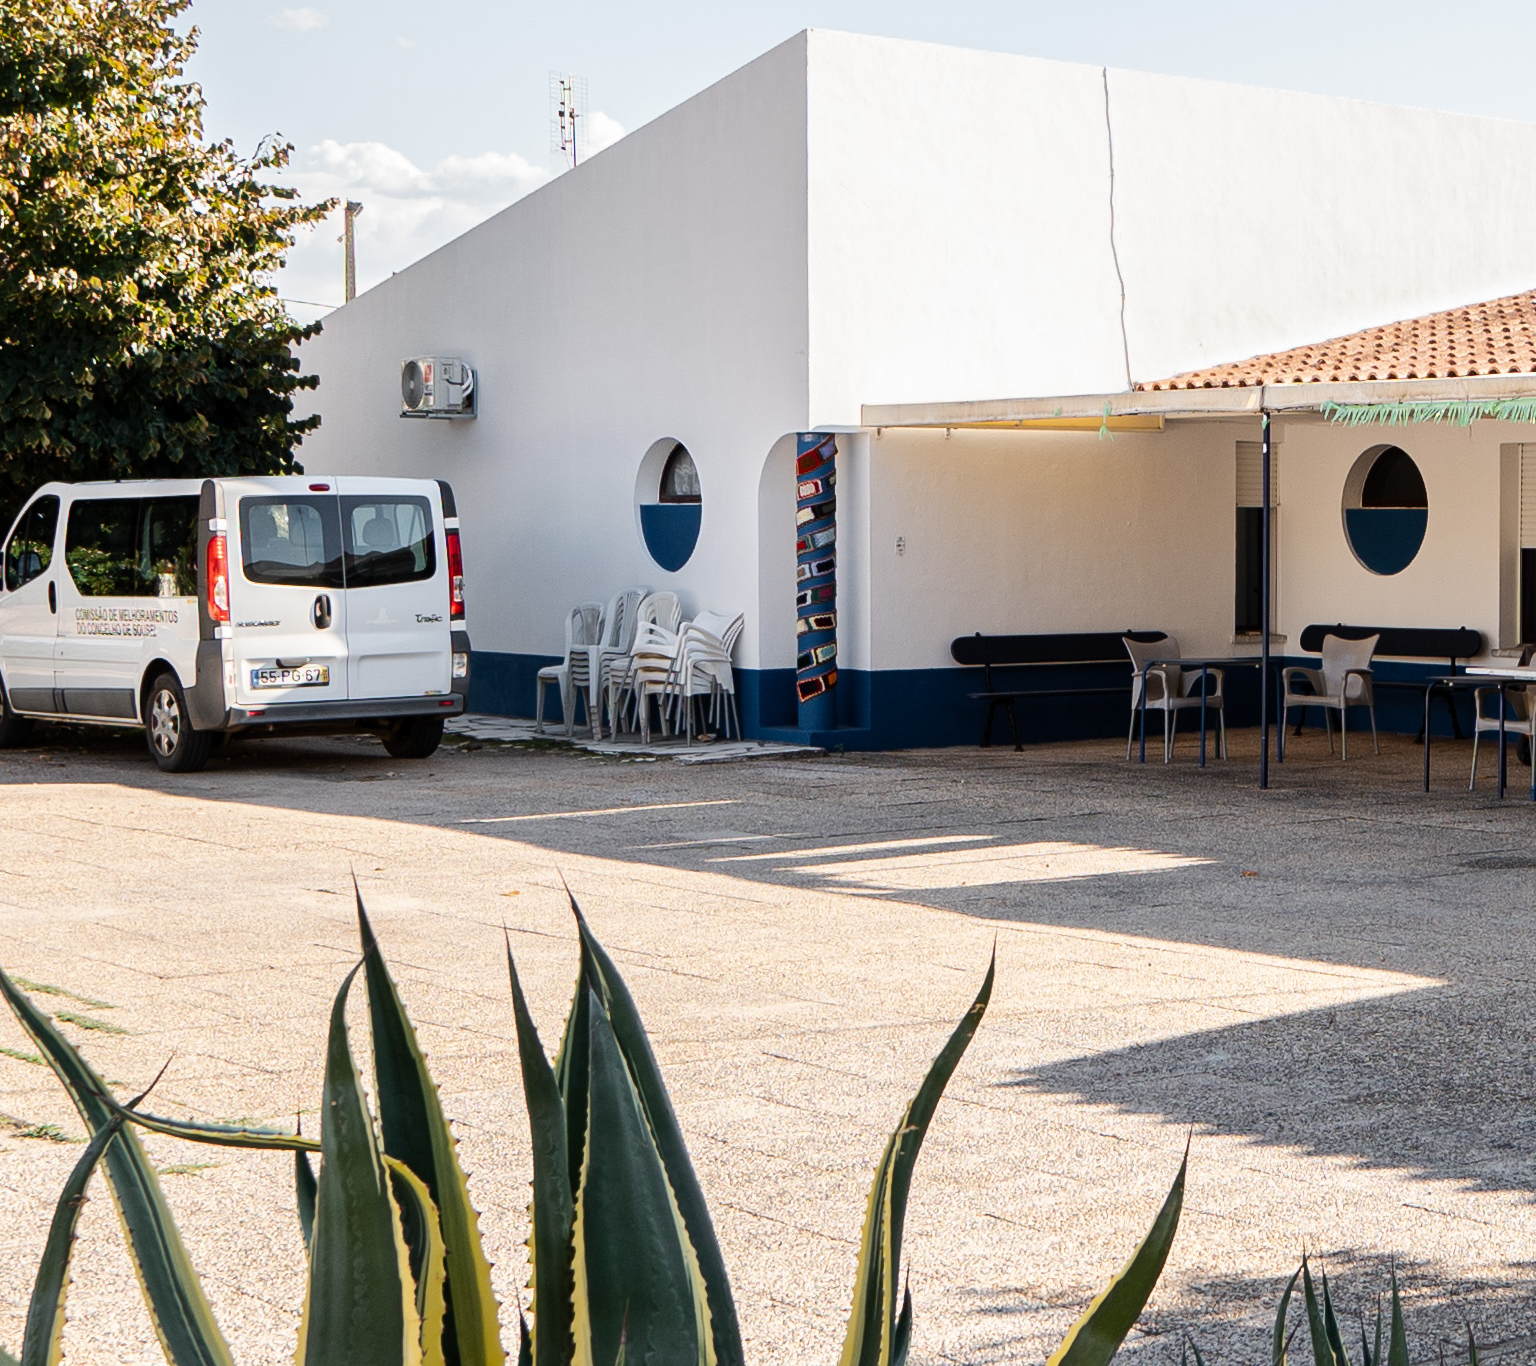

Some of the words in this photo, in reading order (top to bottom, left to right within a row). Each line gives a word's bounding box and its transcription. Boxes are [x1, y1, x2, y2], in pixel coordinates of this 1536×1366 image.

[109, 609, 118, 622] DE
[76, 622, 86, 635] DO
[122, 623, 132, 636] DE
[260, 669, 320, 684] 55-PG-67
